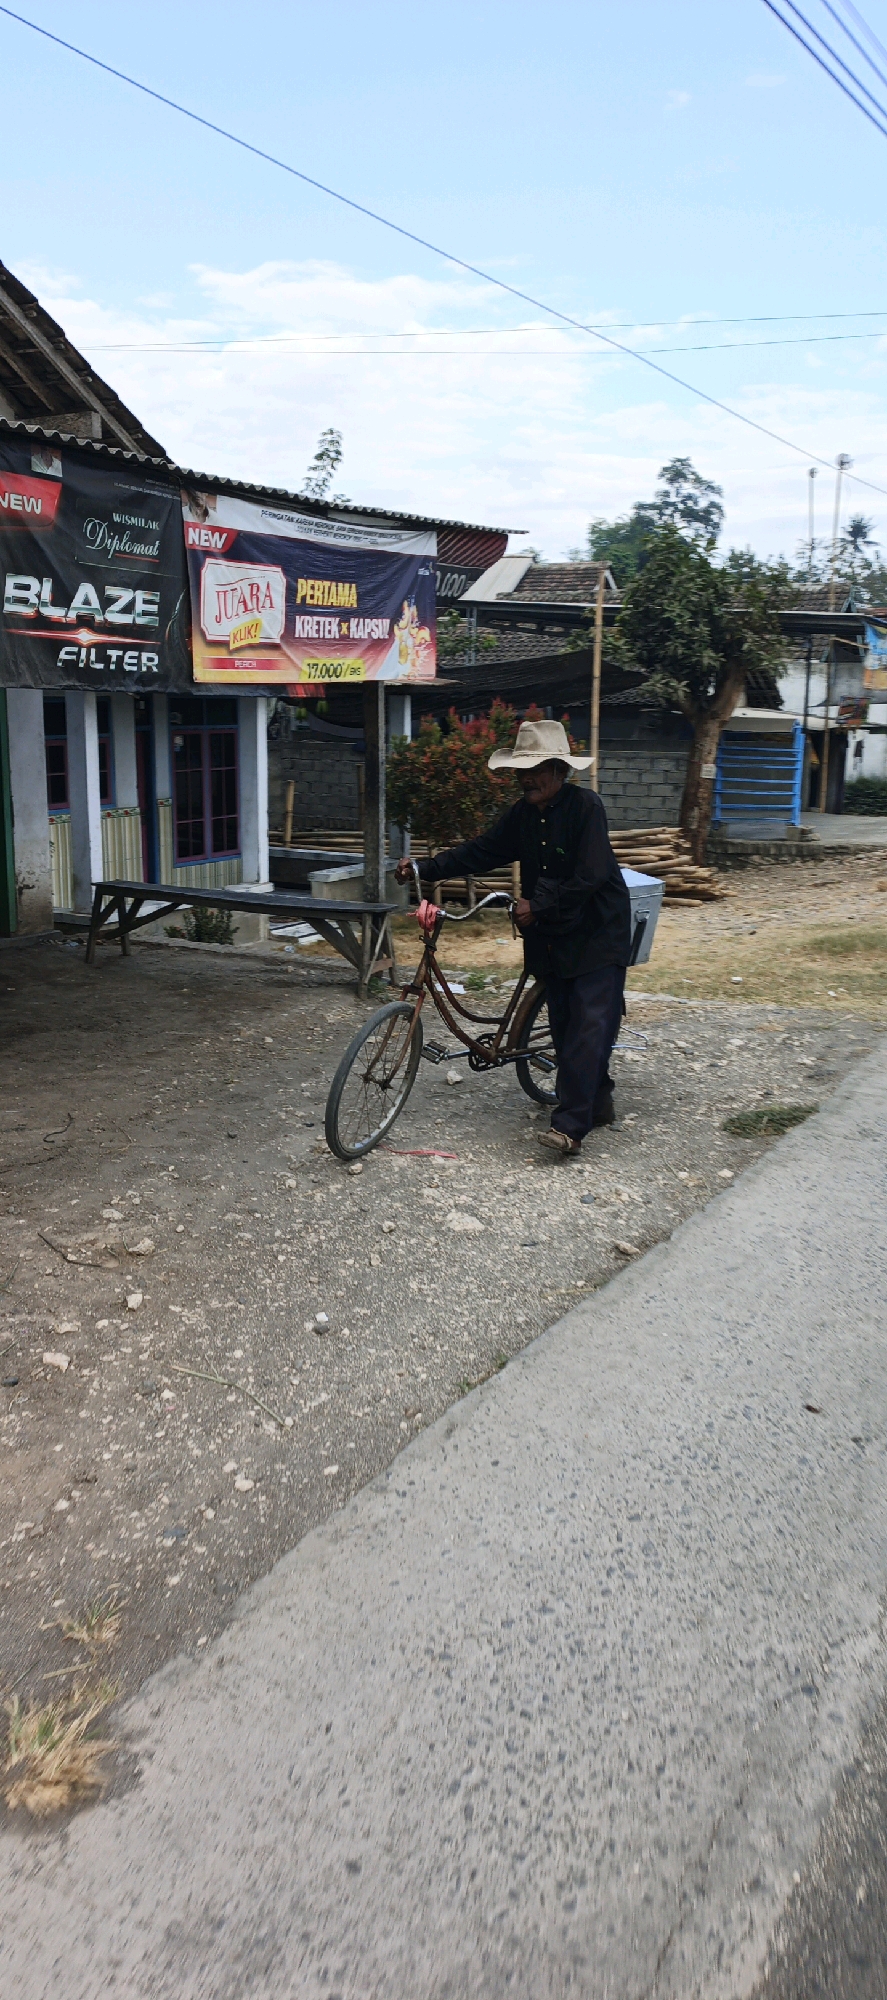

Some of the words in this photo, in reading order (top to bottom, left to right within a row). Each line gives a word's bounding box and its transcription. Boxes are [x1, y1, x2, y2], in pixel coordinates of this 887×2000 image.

[0, 492, 42, 515] NEW
[112, 512, 160, 530] WISMILAK
[83, 517, 160, 559] Diplomat
[188, 527, 228, 549] NEW
[3, 573, 161, 628] BLAZE
[214, 580, 276, 625] JUARA
[296, 578, 358, 608] PERTAMA
[232, 622, 260, 645] KLIK!
[294, 615, 341, 639] KRETEK
[57, 646, 160, 672] FILTER
